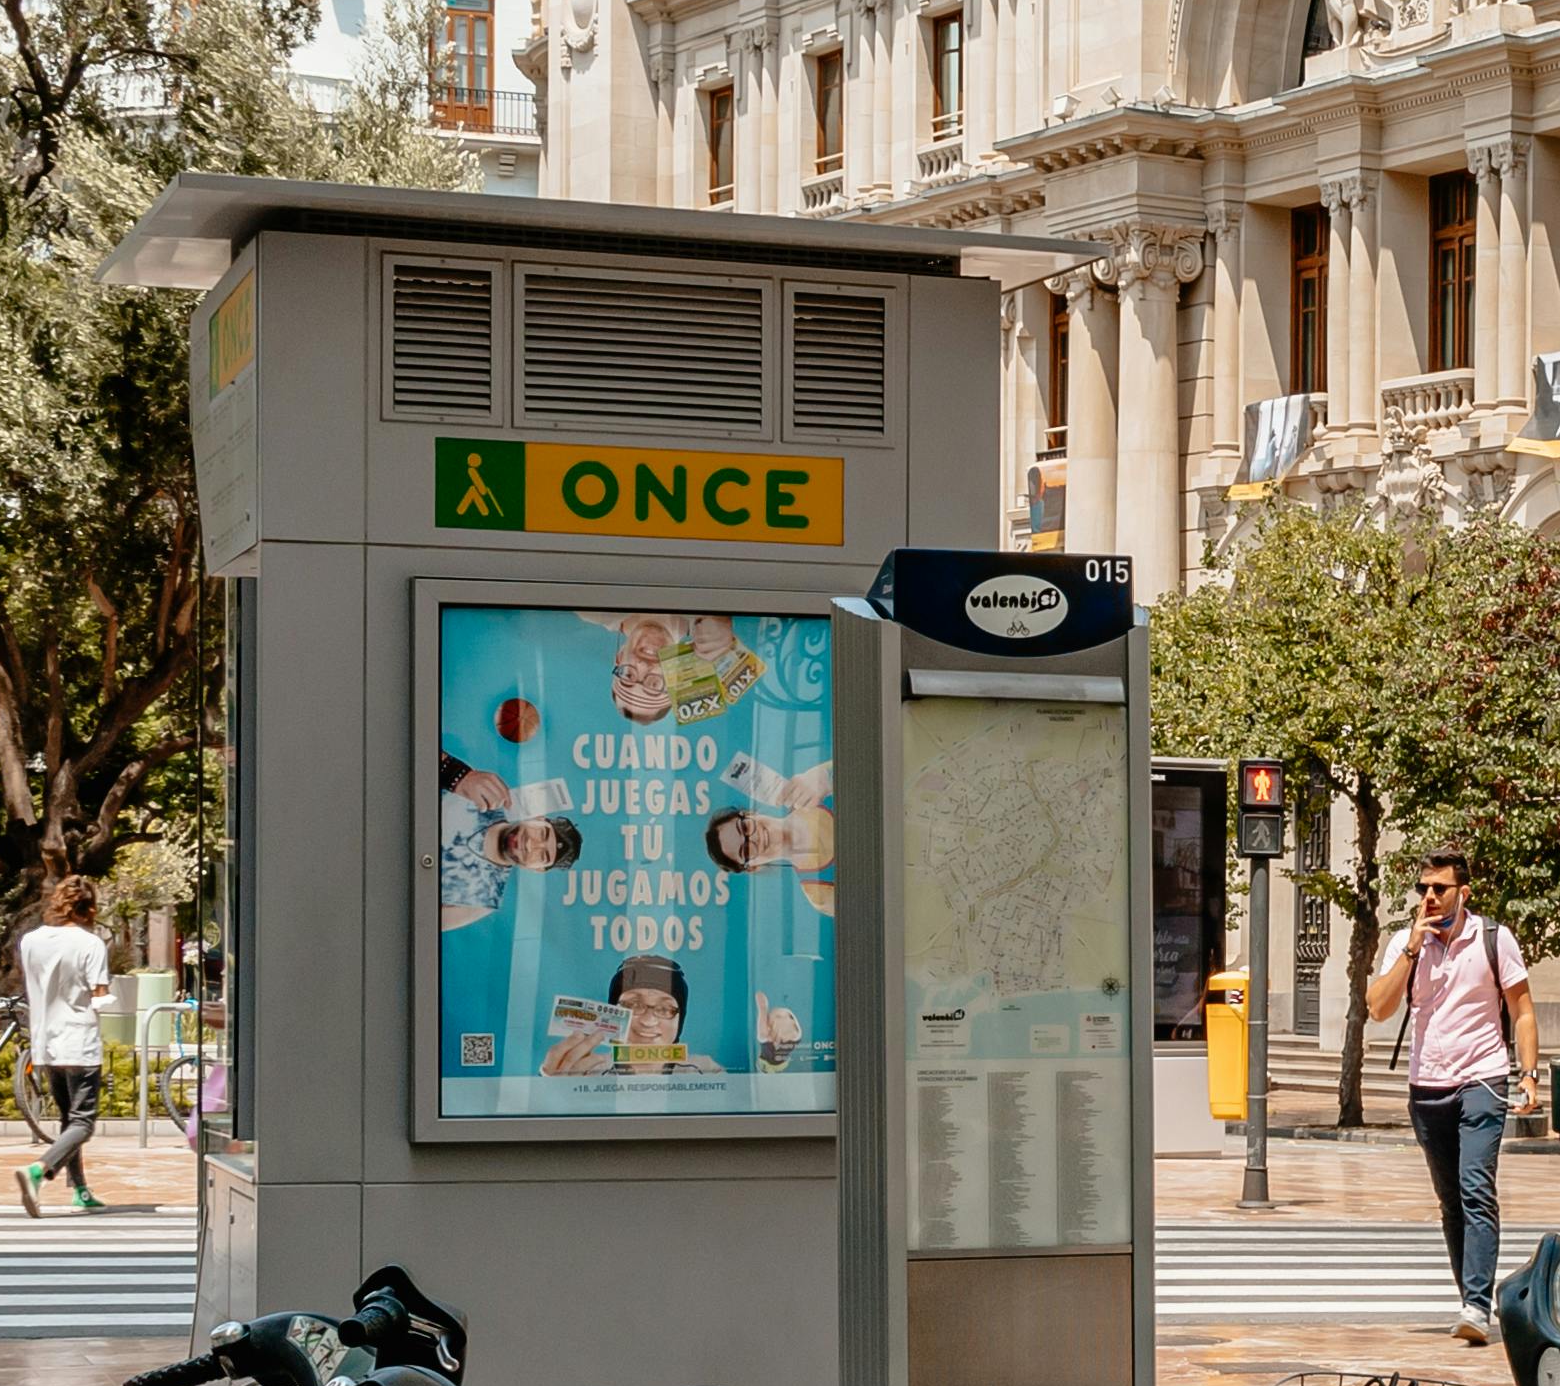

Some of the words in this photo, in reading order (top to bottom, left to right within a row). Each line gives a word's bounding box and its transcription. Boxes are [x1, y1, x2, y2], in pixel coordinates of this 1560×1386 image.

[561, 459, 810, 530] ONCE
[1085, 559, 1130, 584] 015
[969, 587, 1061, 615] valenbisi
[572, 733, 718, 772] CUANDO
[581, 779, 711, 815] JUEGAS
[620, 816, 675, 864] TÚ,
[562, 869, 731, 906] JUGAMOS
[590, 915, 704, 952] TODOS
[634, 1046, 683, 1060] ONCE
[593, 1083, 626, 1093] JUEGA
[626, 1082, 728, 1093] RESPONSABLEMENTE
